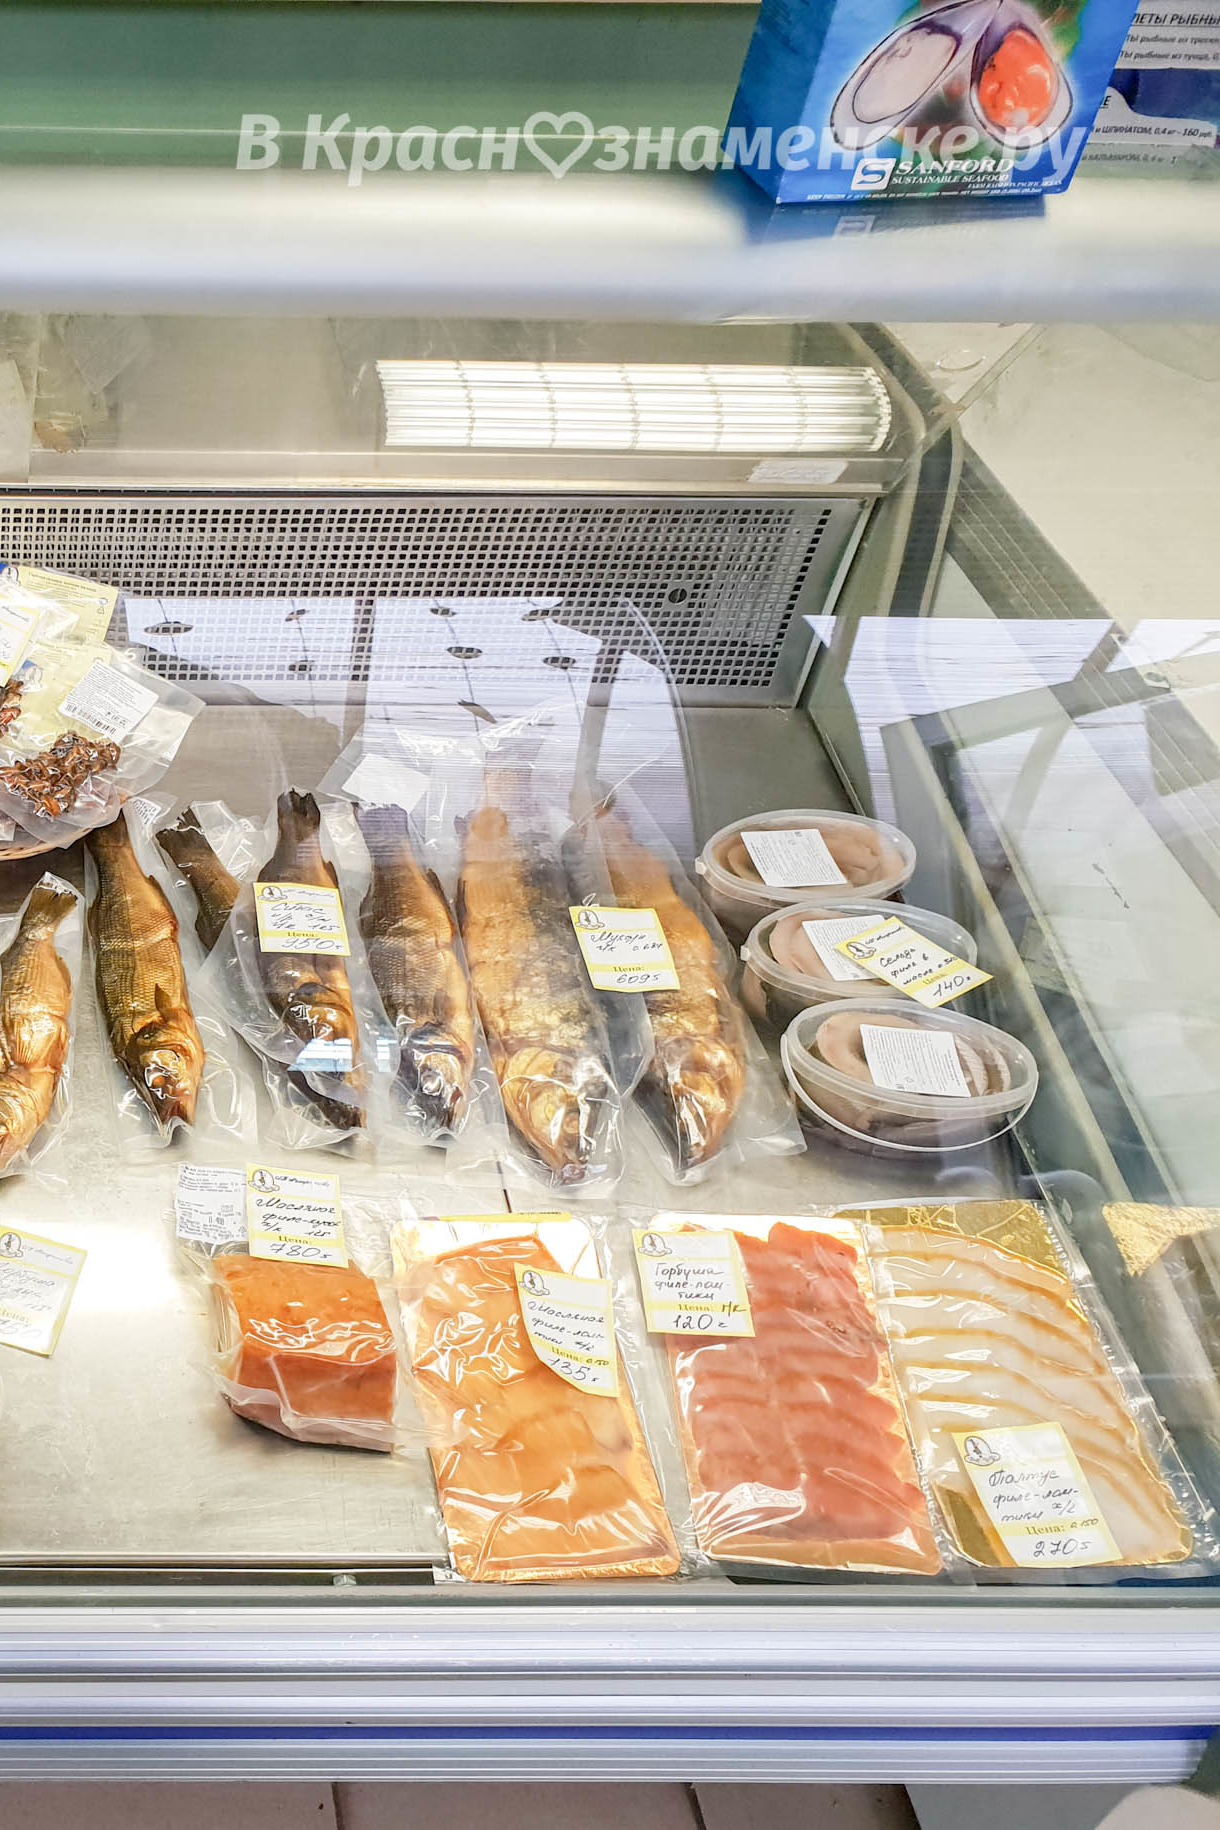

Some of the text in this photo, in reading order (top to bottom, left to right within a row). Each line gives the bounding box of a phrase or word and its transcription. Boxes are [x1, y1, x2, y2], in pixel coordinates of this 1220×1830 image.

[895, 158, 1016, 174] SANFORD
[891, 173, 1009, 185] SUSTAINABLE SEAFOOD
[1026, 1524, 1066, 1535] Цена:
